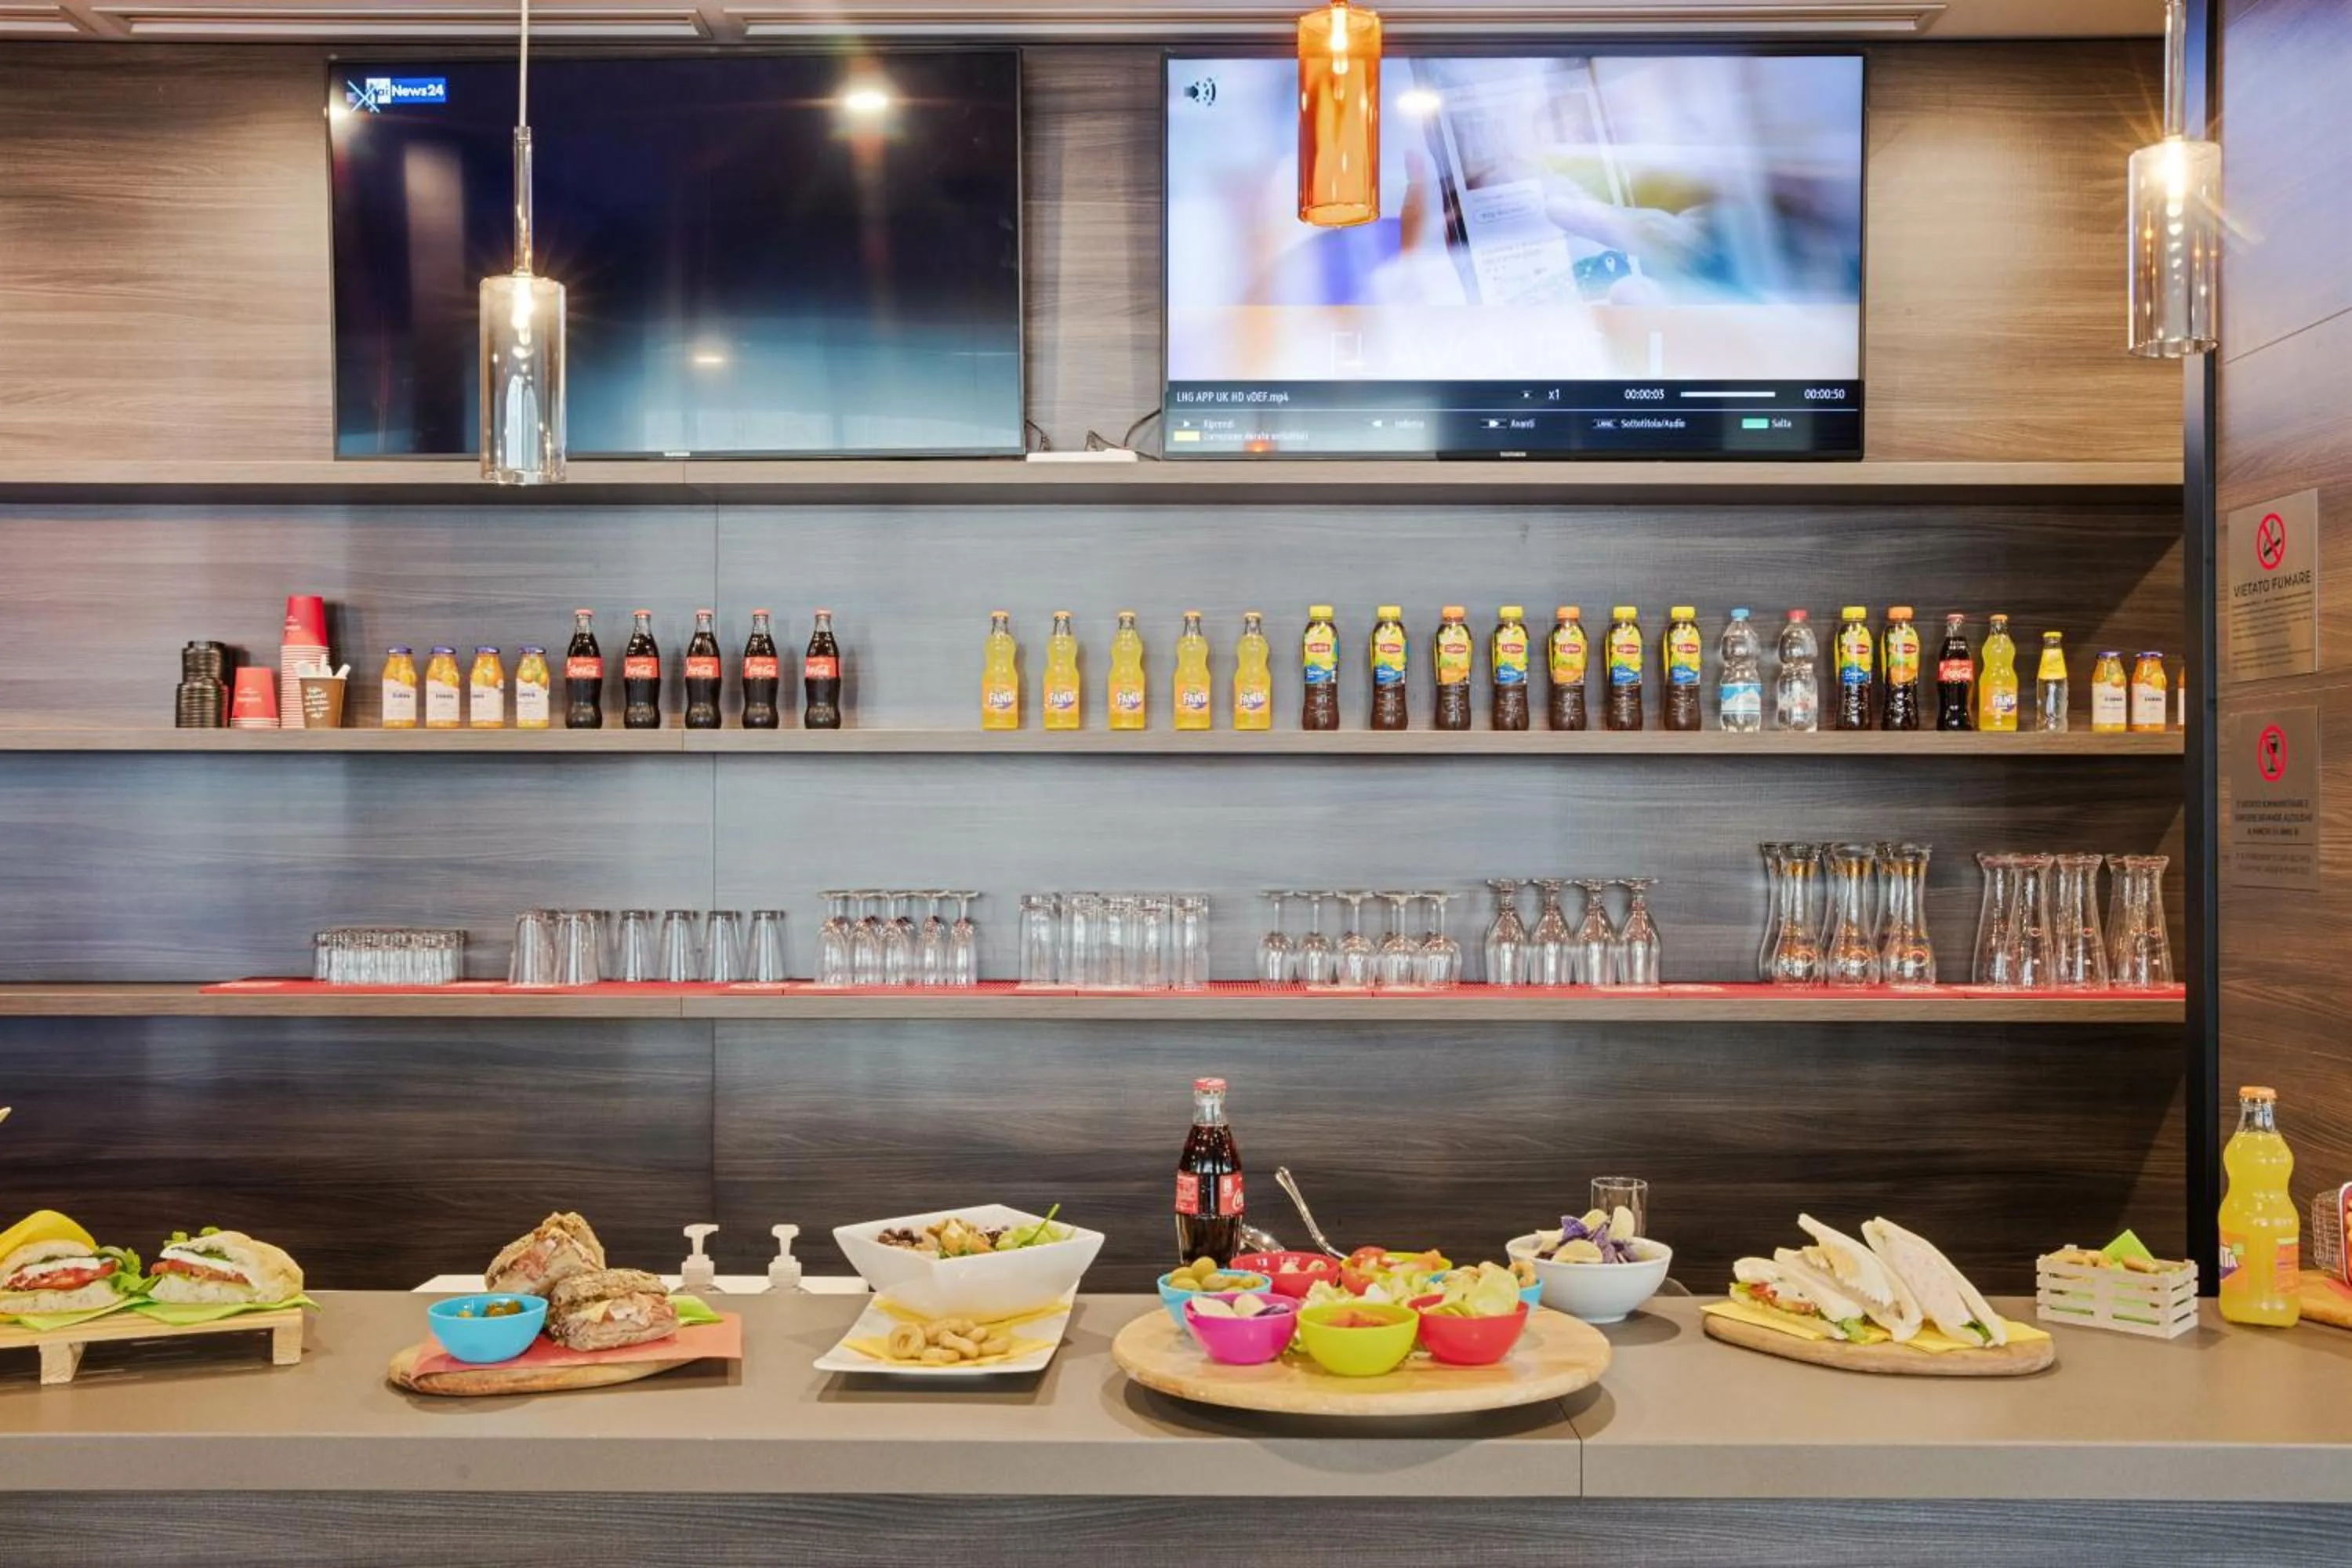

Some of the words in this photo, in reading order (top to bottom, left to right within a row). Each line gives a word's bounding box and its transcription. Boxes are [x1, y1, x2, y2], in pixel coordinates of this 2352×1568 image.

[392, 84, 444, 96] News24
[1177, 392, 1194, 402] LHG
[1196, 392, 1214, 402] APP
[1216, 392, 1229, 402] UK
[1231, 392, 1244, 402] HD
[1548, 389, 1560, 400] x1
[1624, 389, 1664, 400] 00:00:03
[1804, 389, 1845, 400] 00:00:50
[2234, 579, 2270, 597] VIETATO
[2271, 570, 2311, 590] FUMARE
